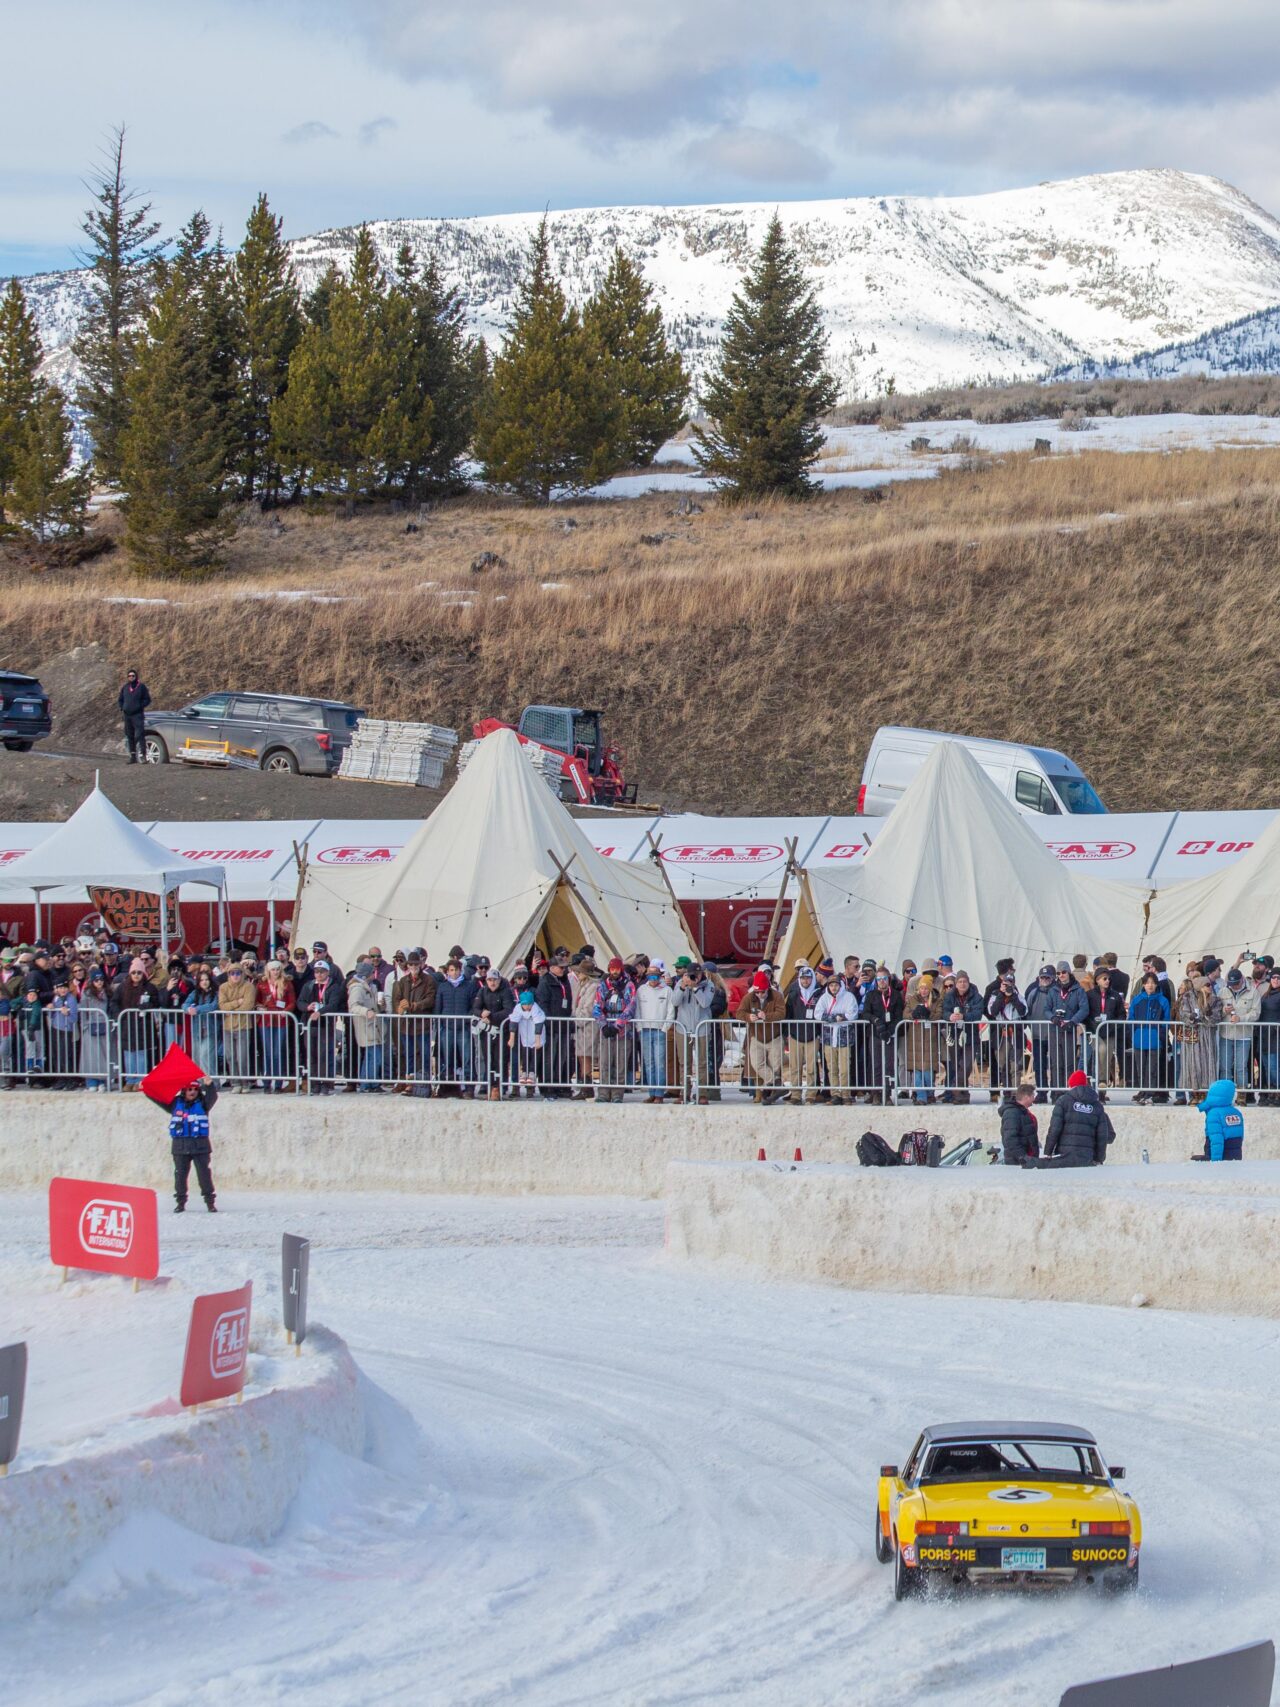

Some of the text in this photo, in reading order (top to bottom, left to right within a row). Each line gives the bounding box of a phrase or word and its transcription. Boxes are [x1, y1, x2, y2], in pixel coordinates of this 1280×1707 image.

[996, 1489, 1043, 1501] 5
[919, 1548, 976, 1562] PORSCHE
[1071, 1548, 1127, 1562] SUNOCO
